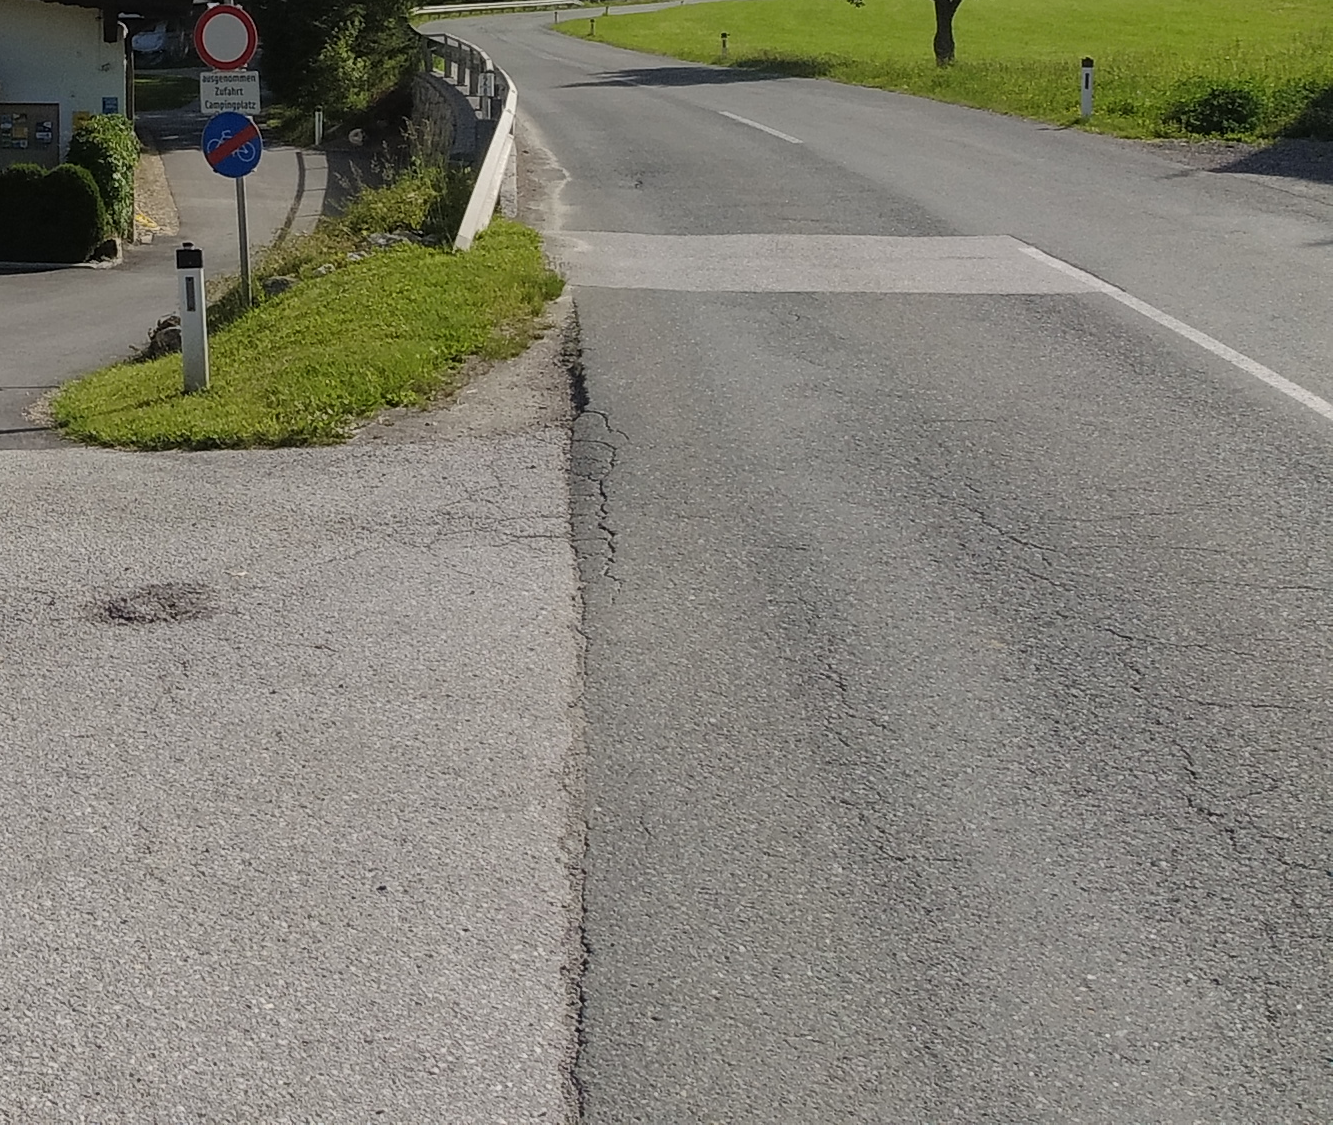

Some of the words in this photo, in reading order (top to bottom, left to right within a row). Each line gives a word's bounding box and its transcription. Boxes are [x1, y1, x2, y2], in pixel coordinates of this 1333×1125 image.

[202, 75, 256, 85] ausgenommen
[214, 86, 244, 96] Zufahrt
[205, 100, 256, 111] Campingplatz
